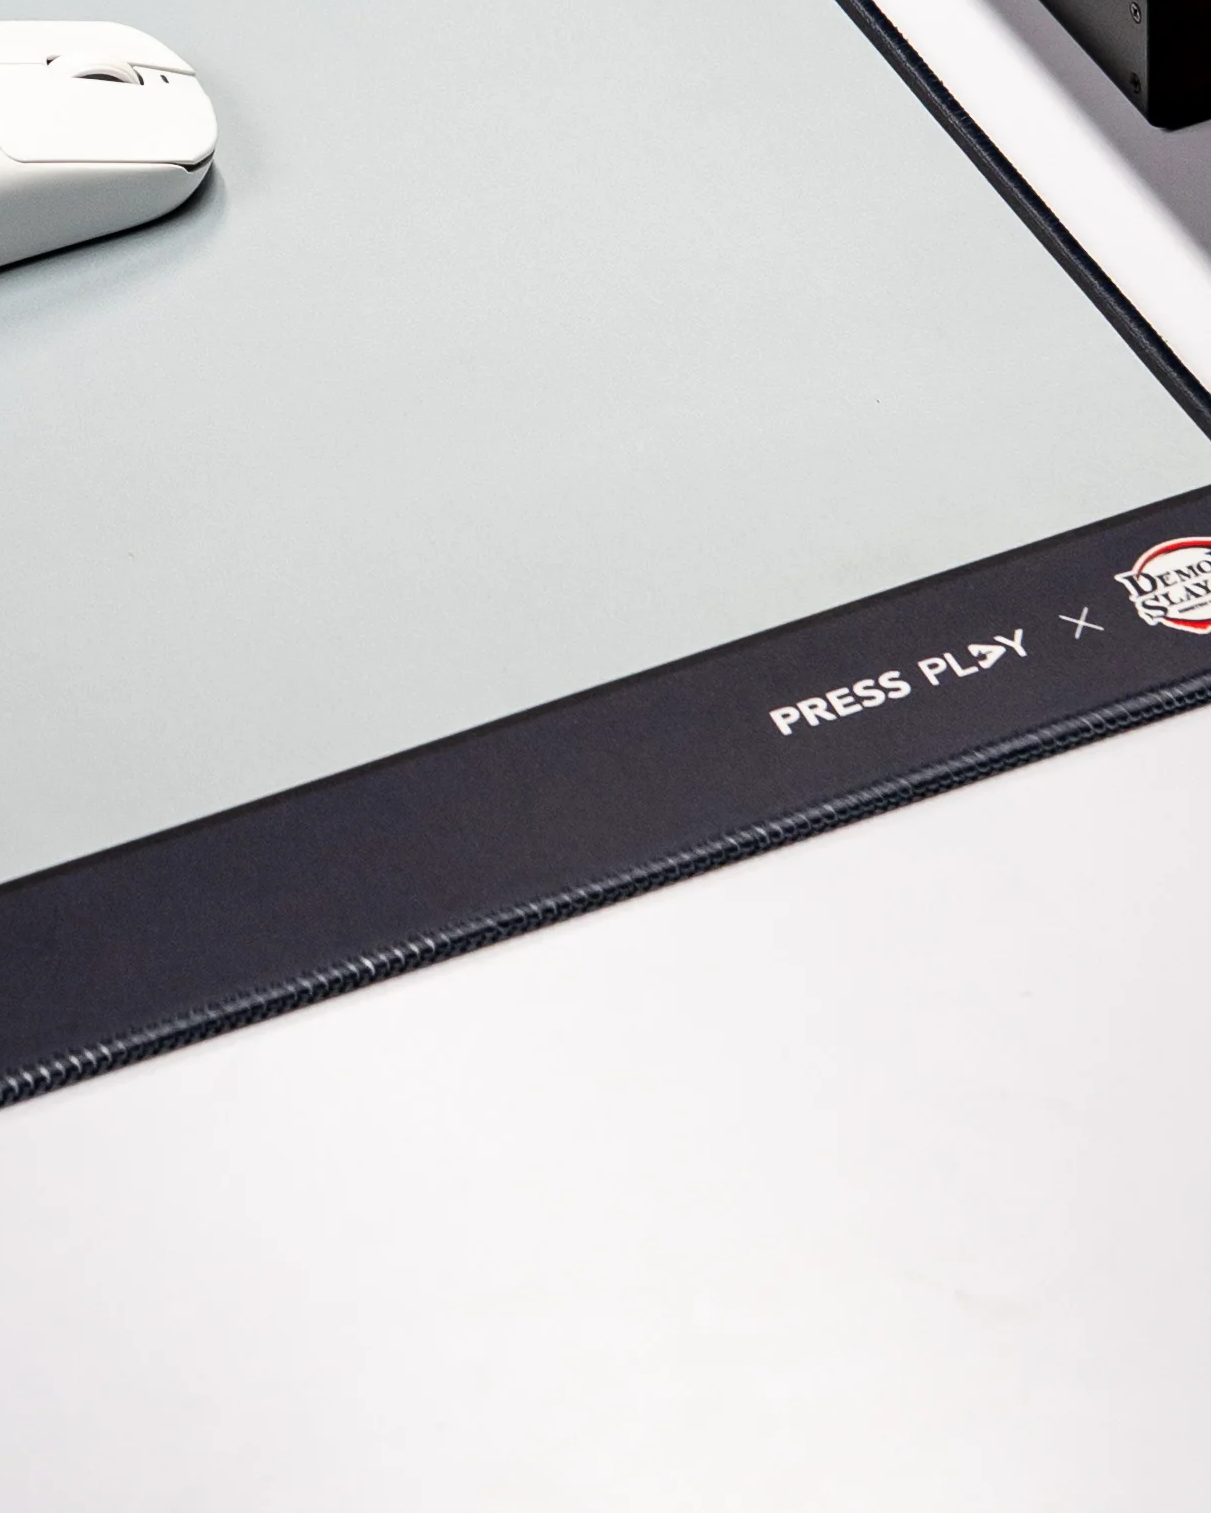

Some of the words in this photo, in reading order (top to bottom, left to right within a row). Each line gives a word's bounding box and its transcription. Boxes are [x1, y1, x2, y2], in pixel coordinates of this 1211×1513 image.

[1122, 559, 1211, 597] DEMO
[1142, 580, 1211, 620] SLAY
[768, 670, 912, 736] PRESS
[918, 628, 1028, 686] PLAY
